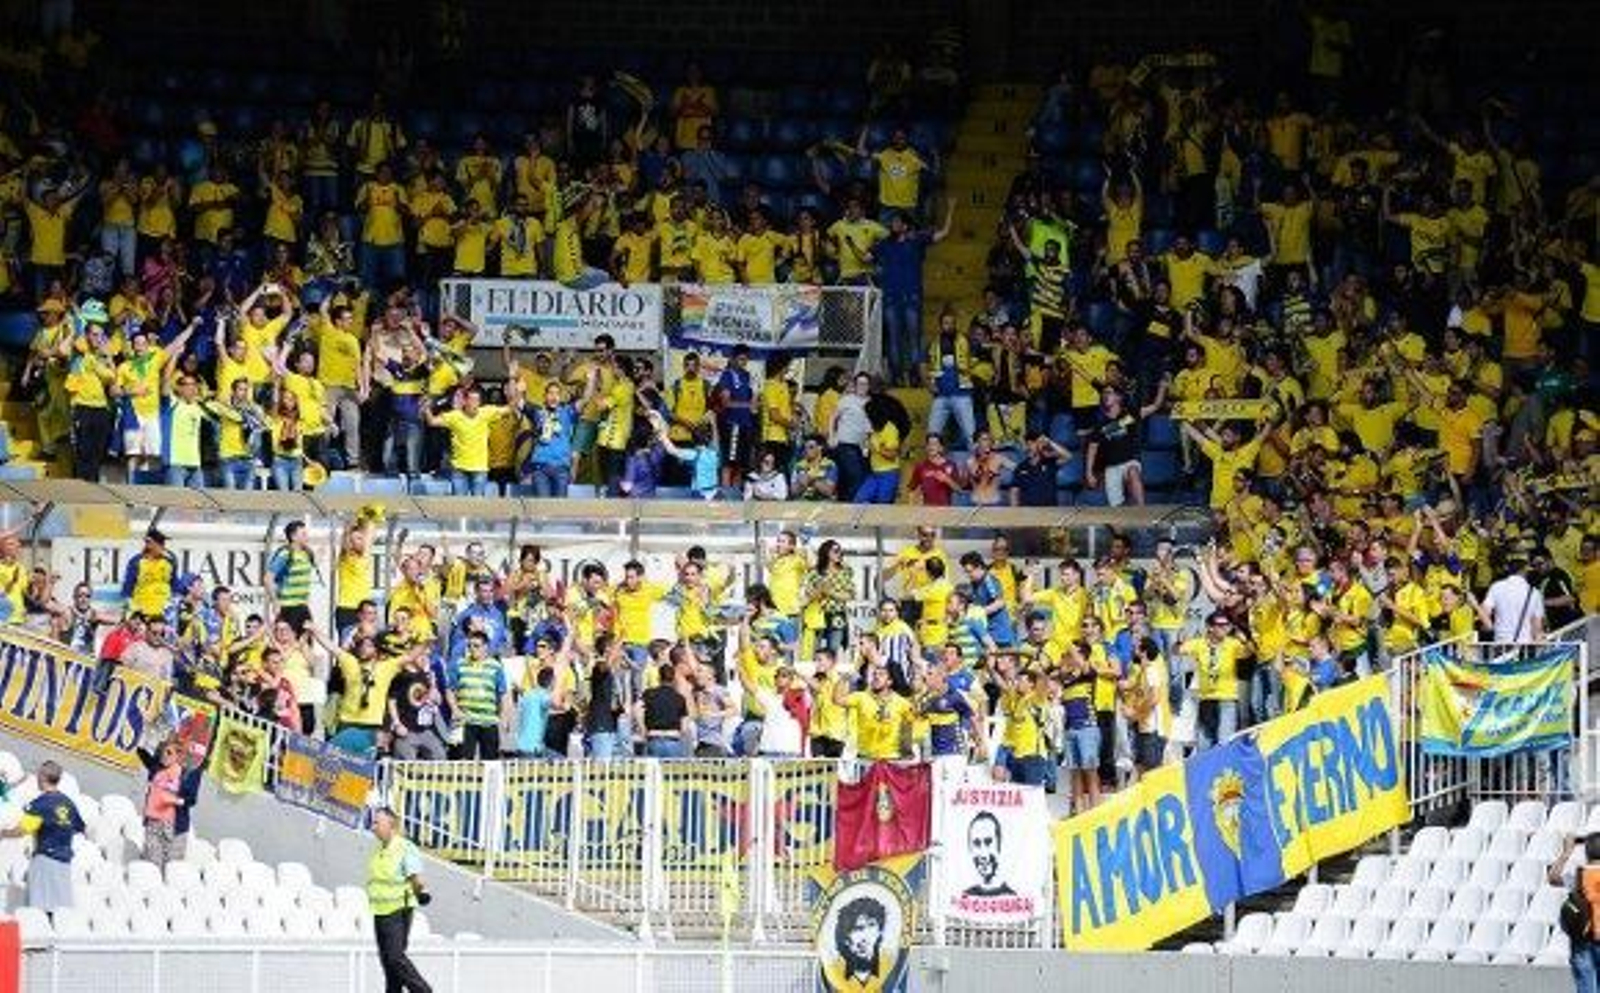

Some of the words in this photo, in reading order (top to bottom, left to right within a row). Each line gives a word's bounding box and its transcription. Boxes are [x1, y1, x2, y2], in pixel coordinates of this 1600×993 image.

[531, 290, 645, 316] DIARIO
[1072, 794, 1197, 934] AMOR
[1267, 696, 1397, 850] ETERNO
